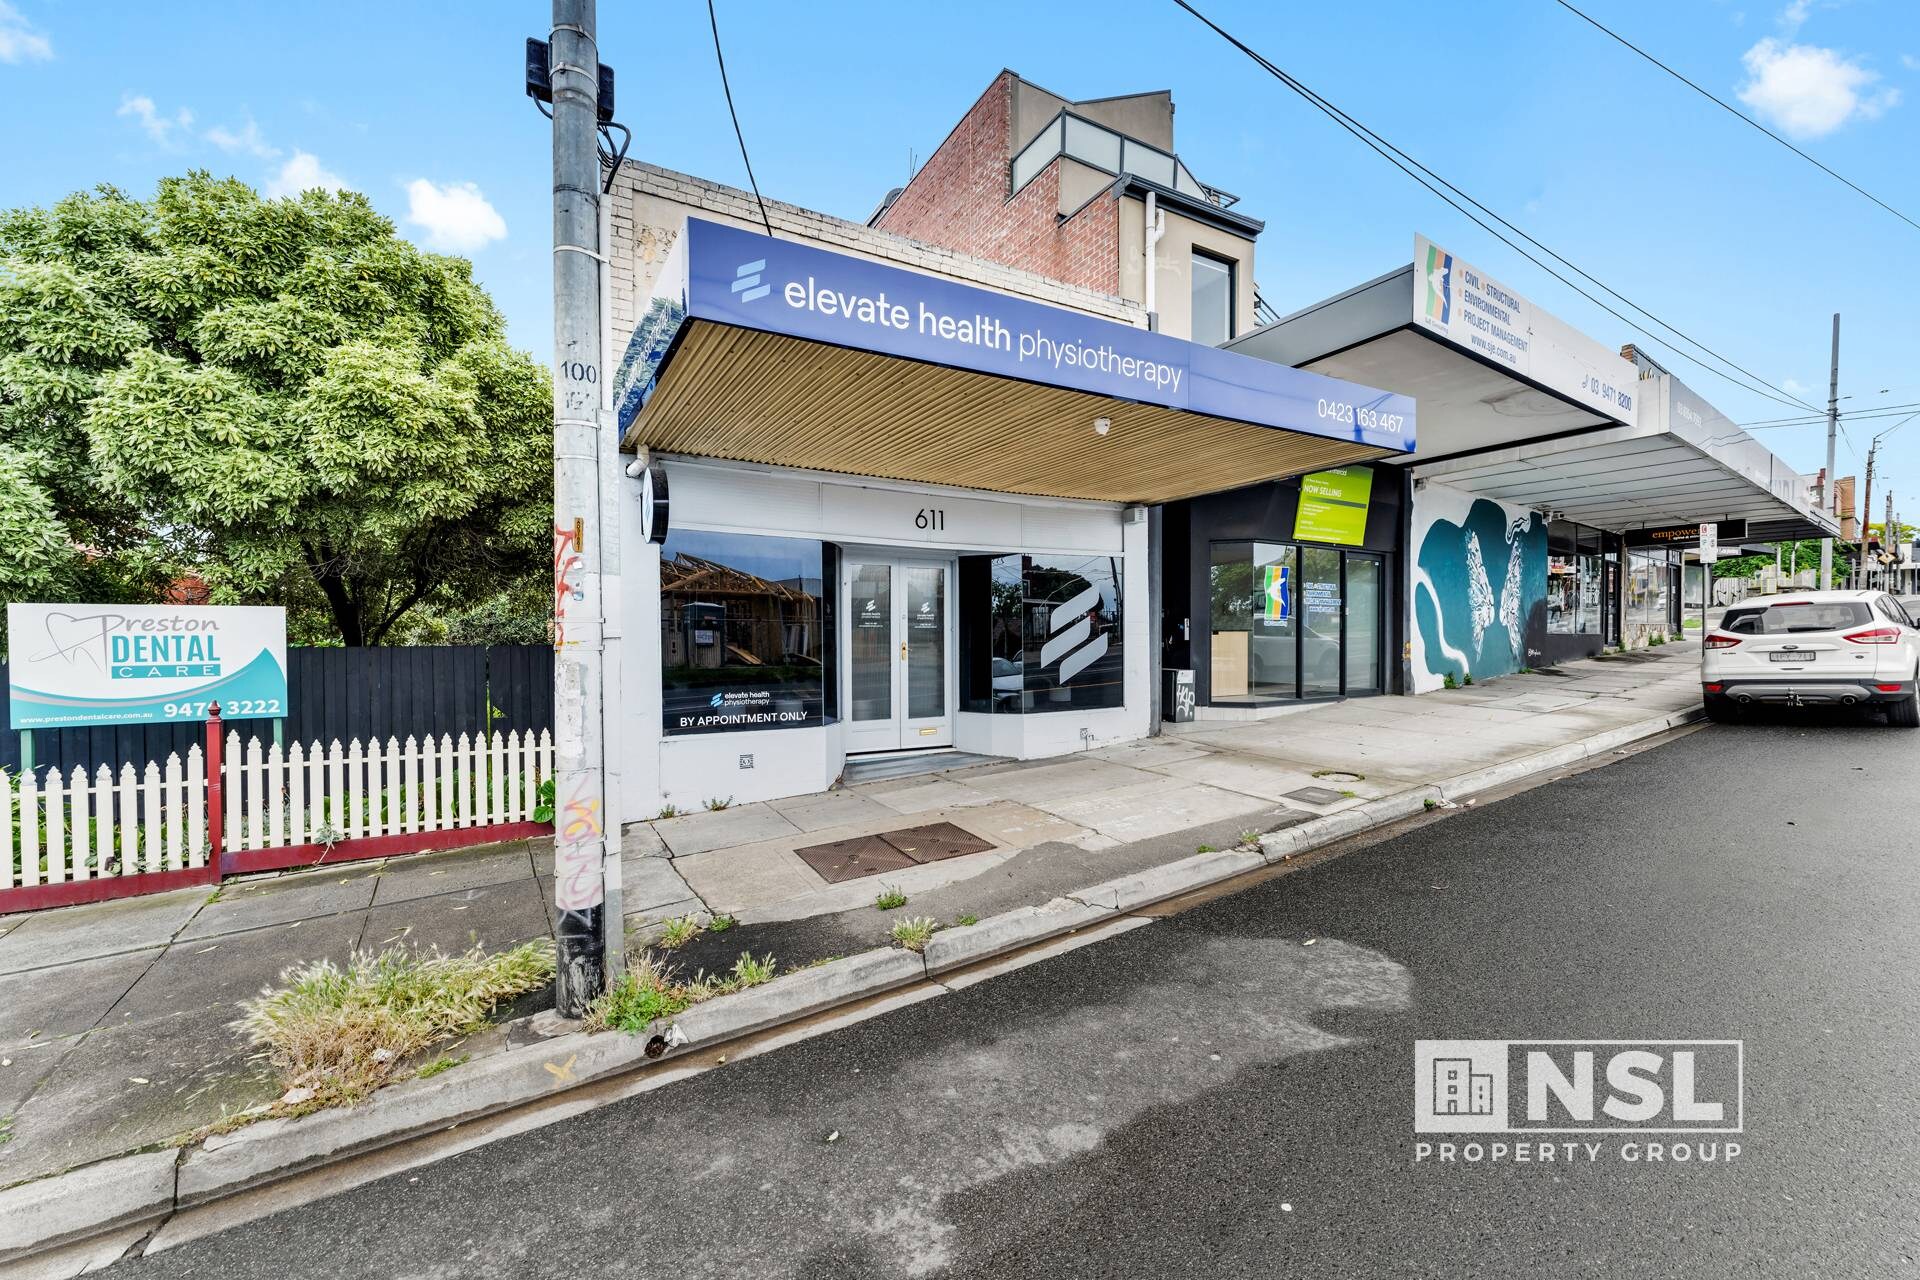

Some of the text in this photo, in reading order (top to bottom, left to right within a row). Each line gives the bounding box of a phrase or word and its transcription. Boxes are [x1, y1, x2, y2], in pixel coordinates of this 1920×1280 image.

[1465, 271, 1520, 313] CIVIL STRUCTURAL
[1464, 290, 1511, 326] ENVIRONMENTAL
[784, 276, 1182, 393] elevate health physiotherapy
[1464, 310, 1490, 333] PROJECT
[1491, 324, 1528, 352] MANAGEMENT
[1471, 335, 1517, 364] www.sje.com.au
[560, 361, 597, 384] 100
[1318, 398, 1404, 433] 0423 163 467
[1303, 484, 1342, 498] NOW SELLING
[915, 508, 944, 531] 611
[111, 634, 221, 663] DENTAL
[119, 664, 215, 678] CARE
[724, 690, 770, 700] elevate health
[724, 698, 770, 707] physiotherapy
[20, 711, 153, 724] www.prestondentalcare.com.au
[163, 699, 281, 718] 947 3222
[680, 710, 808, 727] BY APPOINTMENT ONLY
